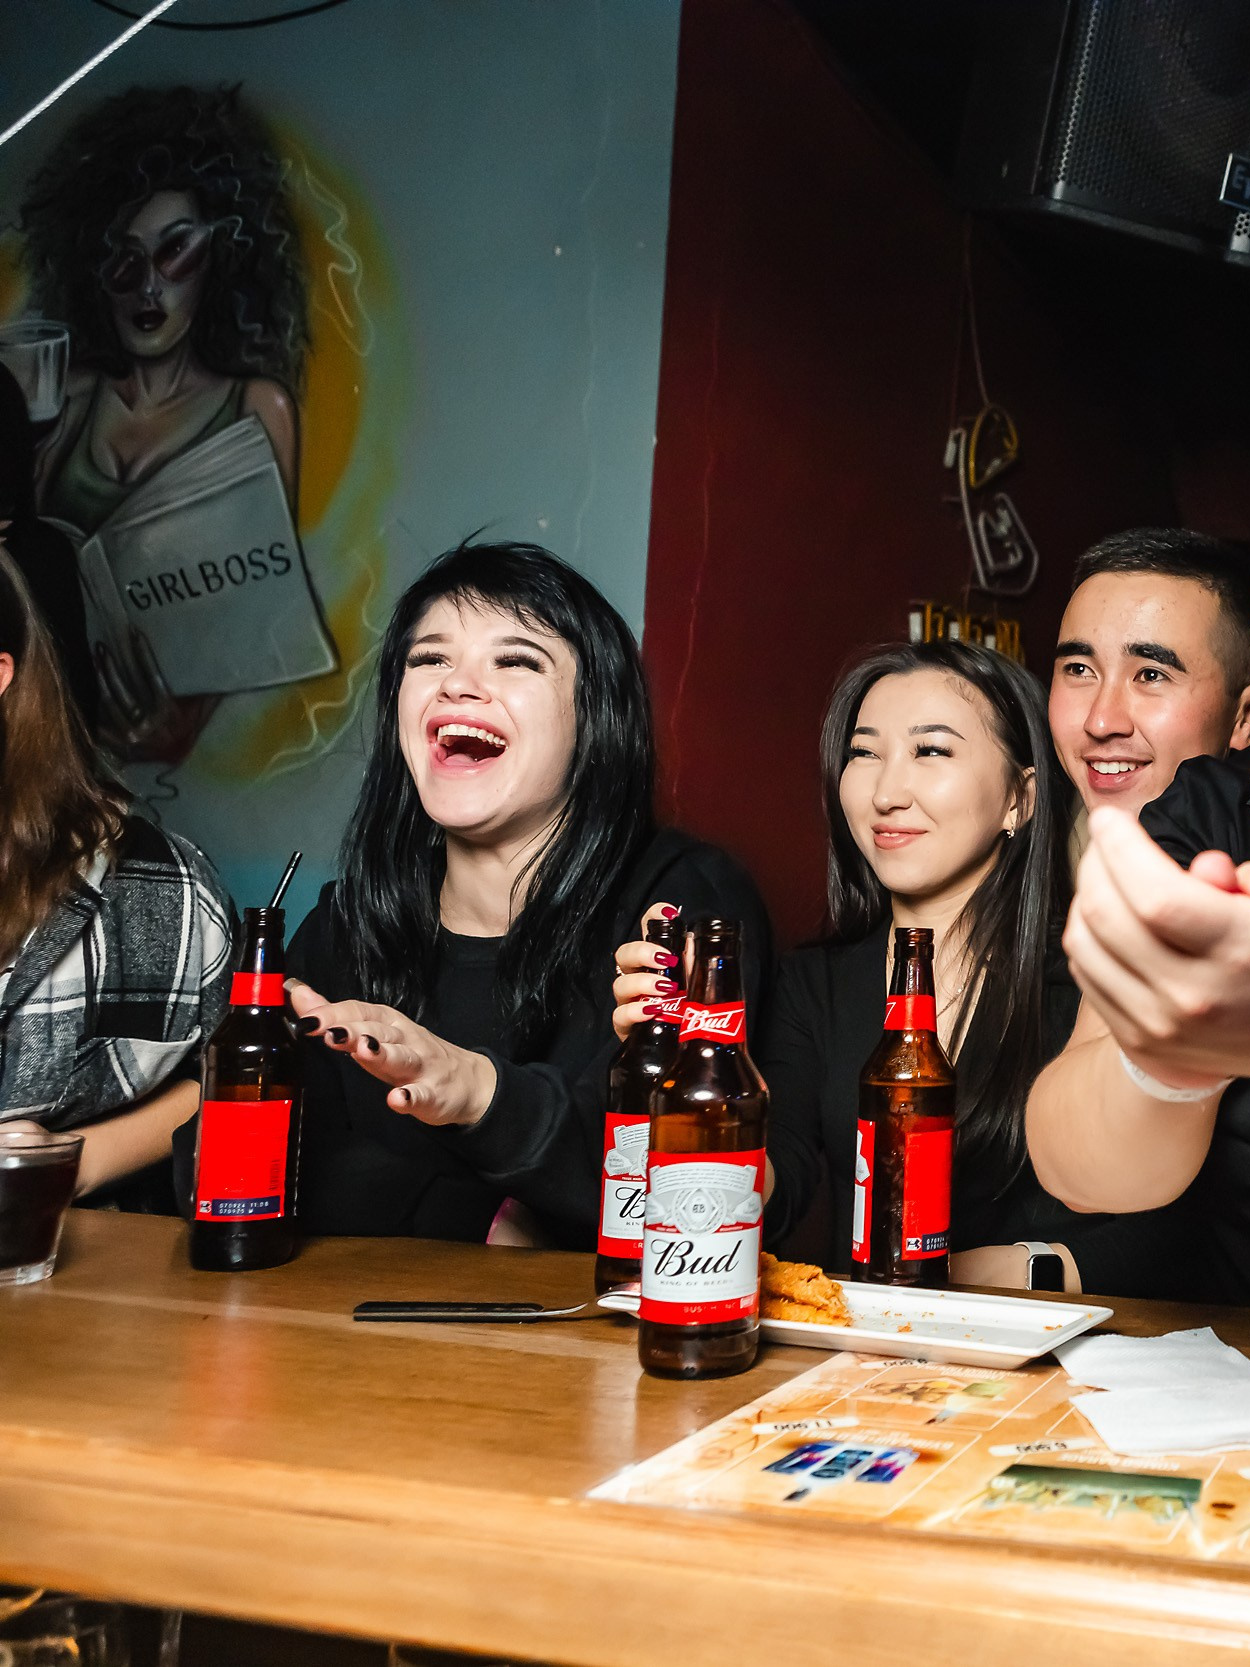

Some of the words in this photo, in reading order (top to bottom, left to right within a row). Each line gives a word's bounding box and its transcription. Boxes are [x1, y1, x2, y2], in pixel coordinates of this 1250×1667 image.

[126, 541, 292, 611] GIRLBOSS
[685, 1006, 731, 1031] Bud
[650, 1238, 744, 1278] Bud
